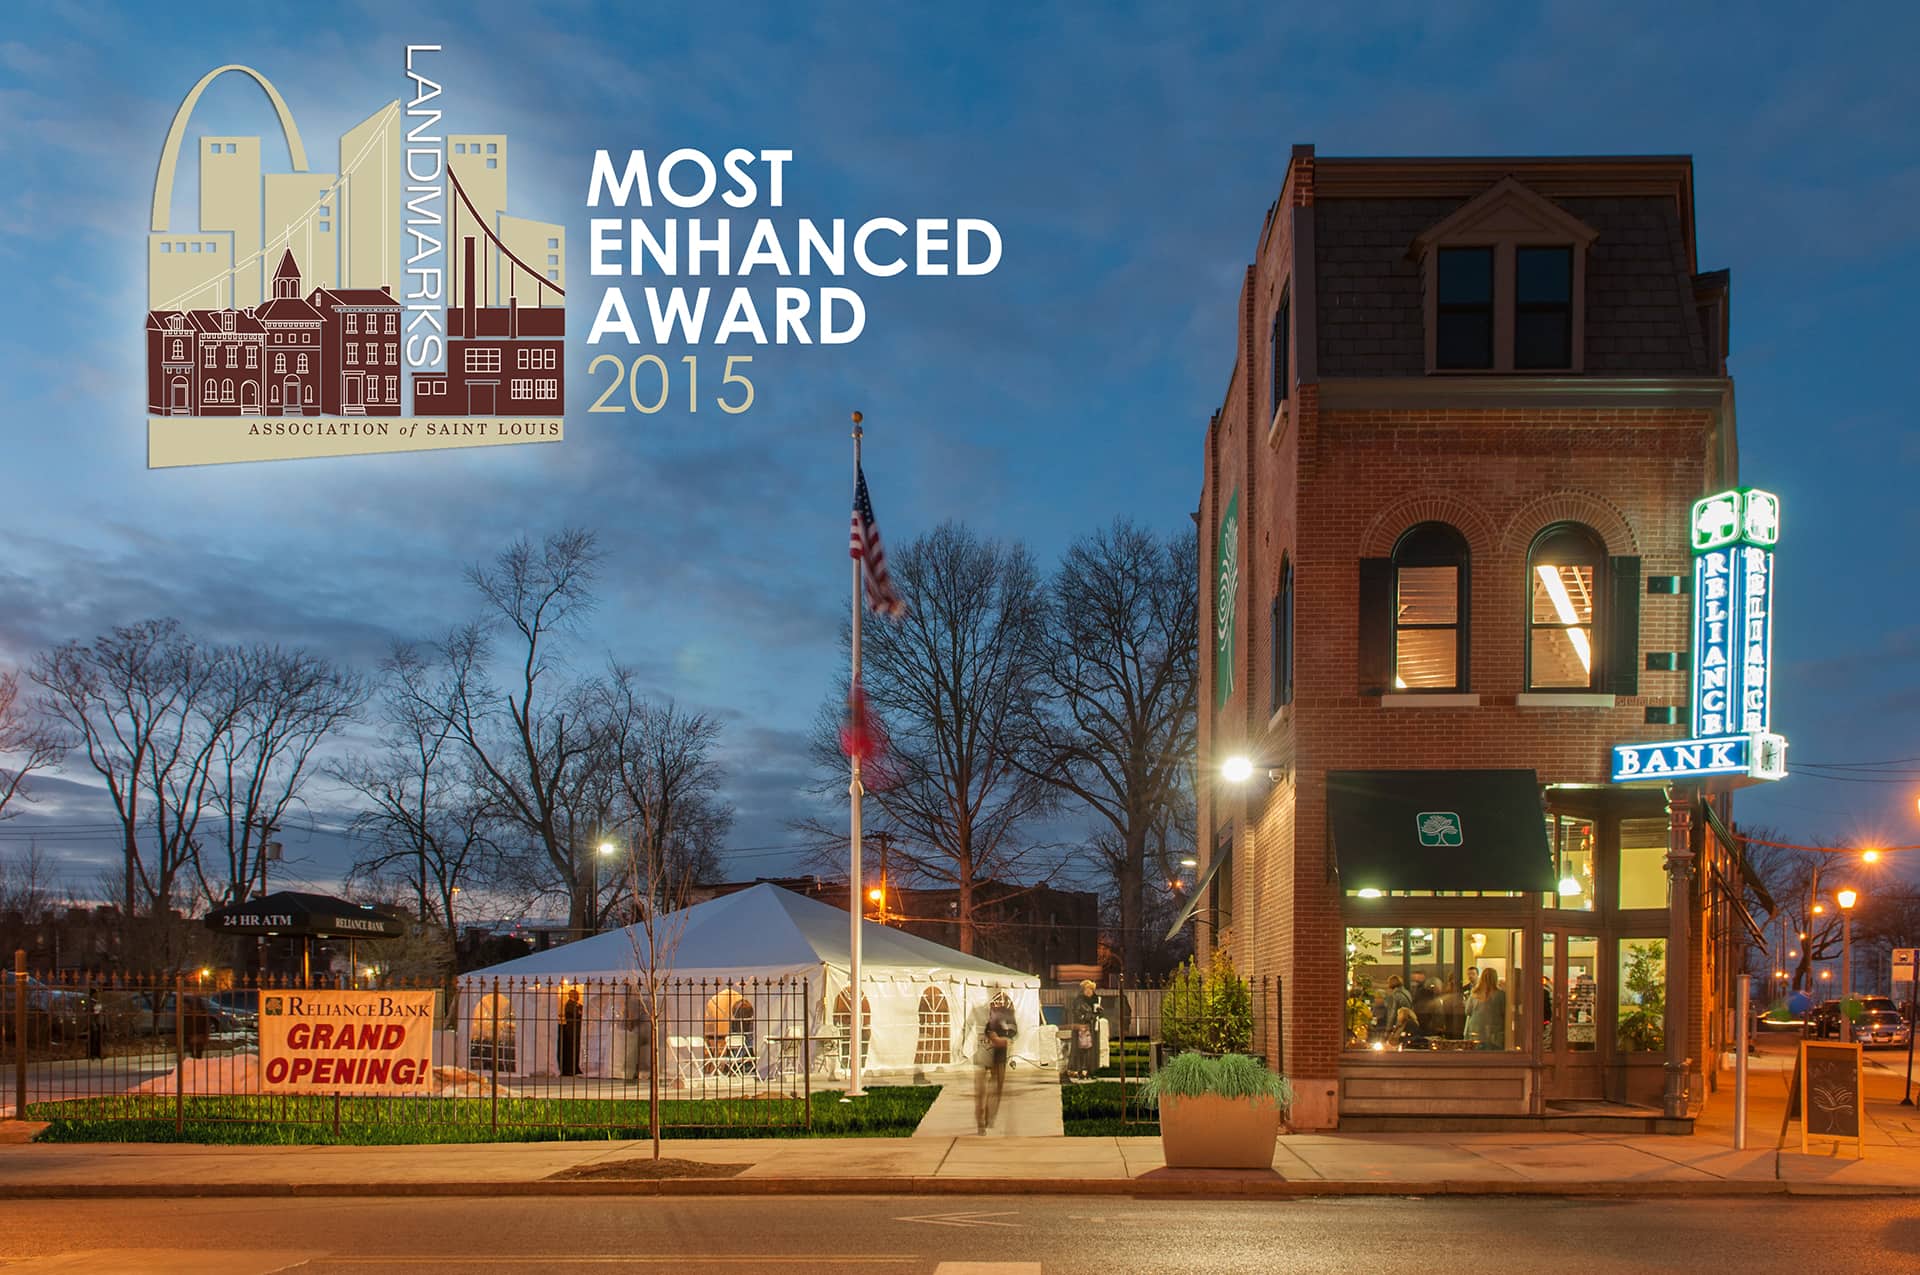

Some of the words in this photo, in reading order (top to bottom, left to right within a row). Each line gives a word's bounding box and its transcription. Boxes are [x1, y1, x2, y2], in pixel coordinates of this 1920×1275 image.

[1701, 552, 1729, 736] RELIANCE
[1618, 741, 1736, 776] BANK
[223, 914, 238, 927] 24
[240, 914, 260, 926] HR
[262, 914, 292, 927] ATM
[335, 917, 367, 931] RELIANCE
[367, 921, 385, 932] BANK
[286, 1023, 406, 1050] GRAND
[265, 1057, 429, 1085] OPENING!
